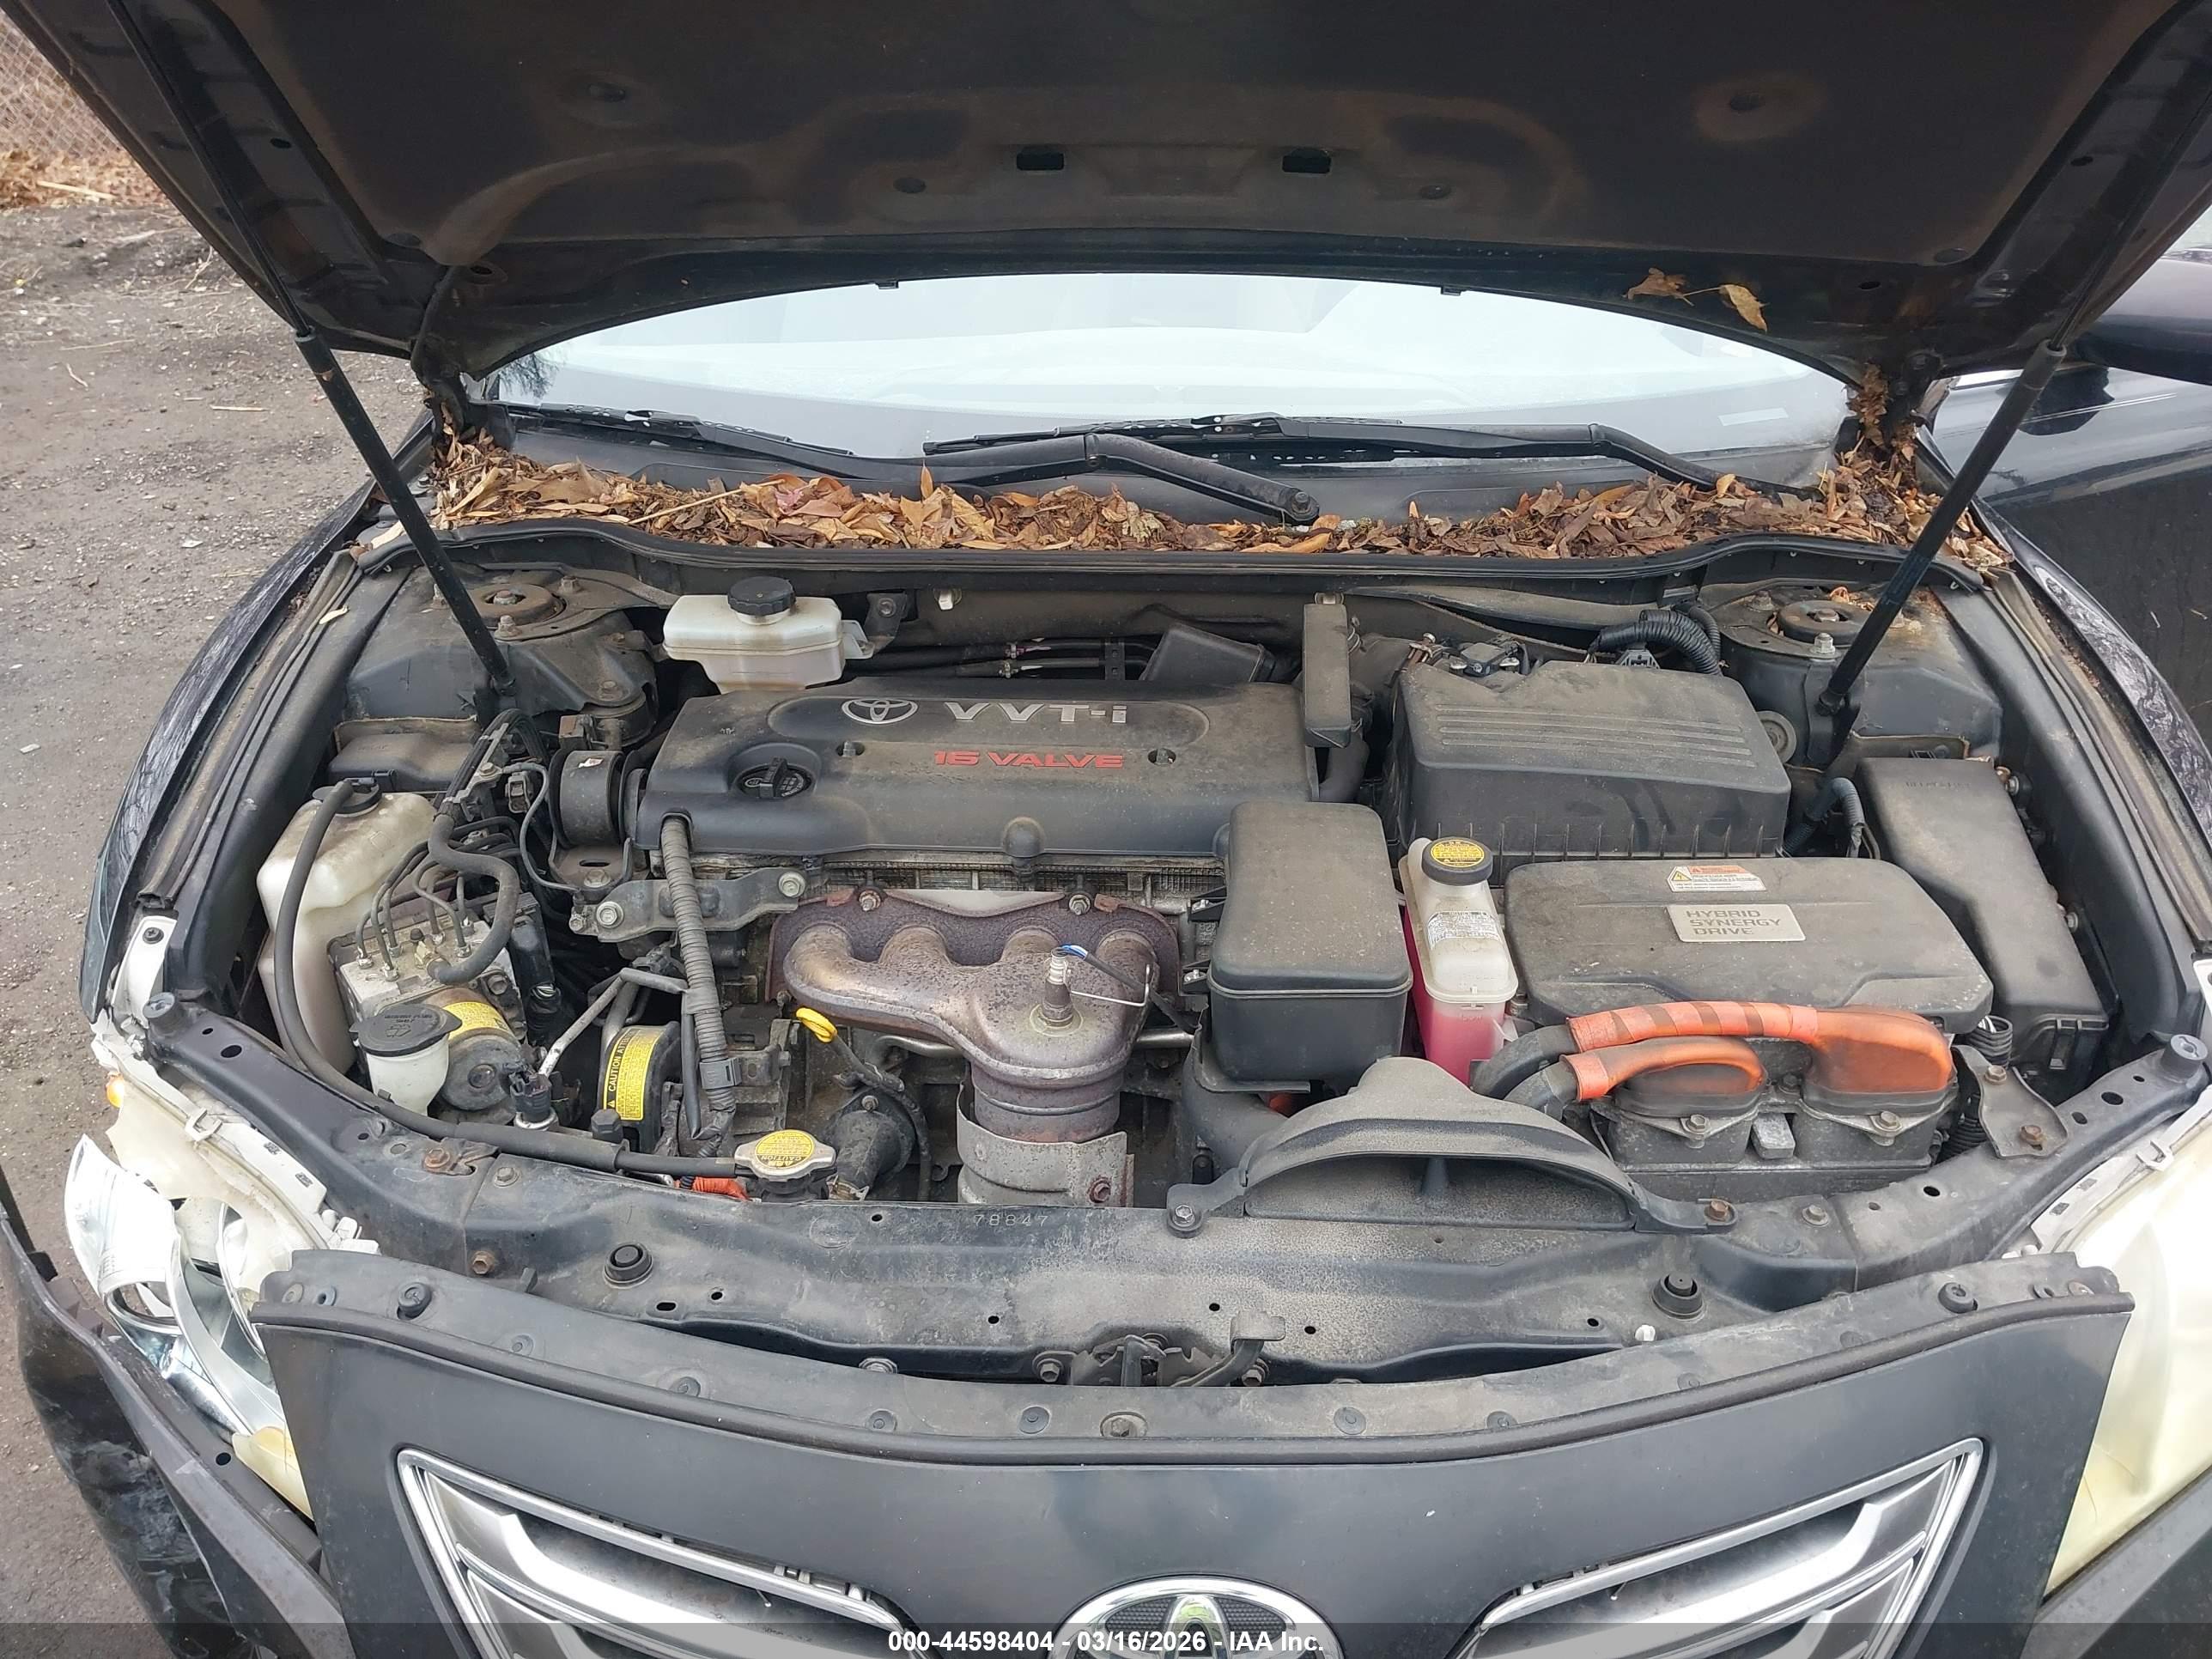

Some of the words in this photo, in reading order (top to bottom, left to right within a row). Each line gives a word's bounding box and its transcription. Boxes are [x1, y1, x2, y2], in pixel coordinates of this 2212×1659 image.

[934, 750, 980, 766] 16
[988, 752, 1123, 769] VALVE
[608, 1058, 621, 1091] CAUTION
